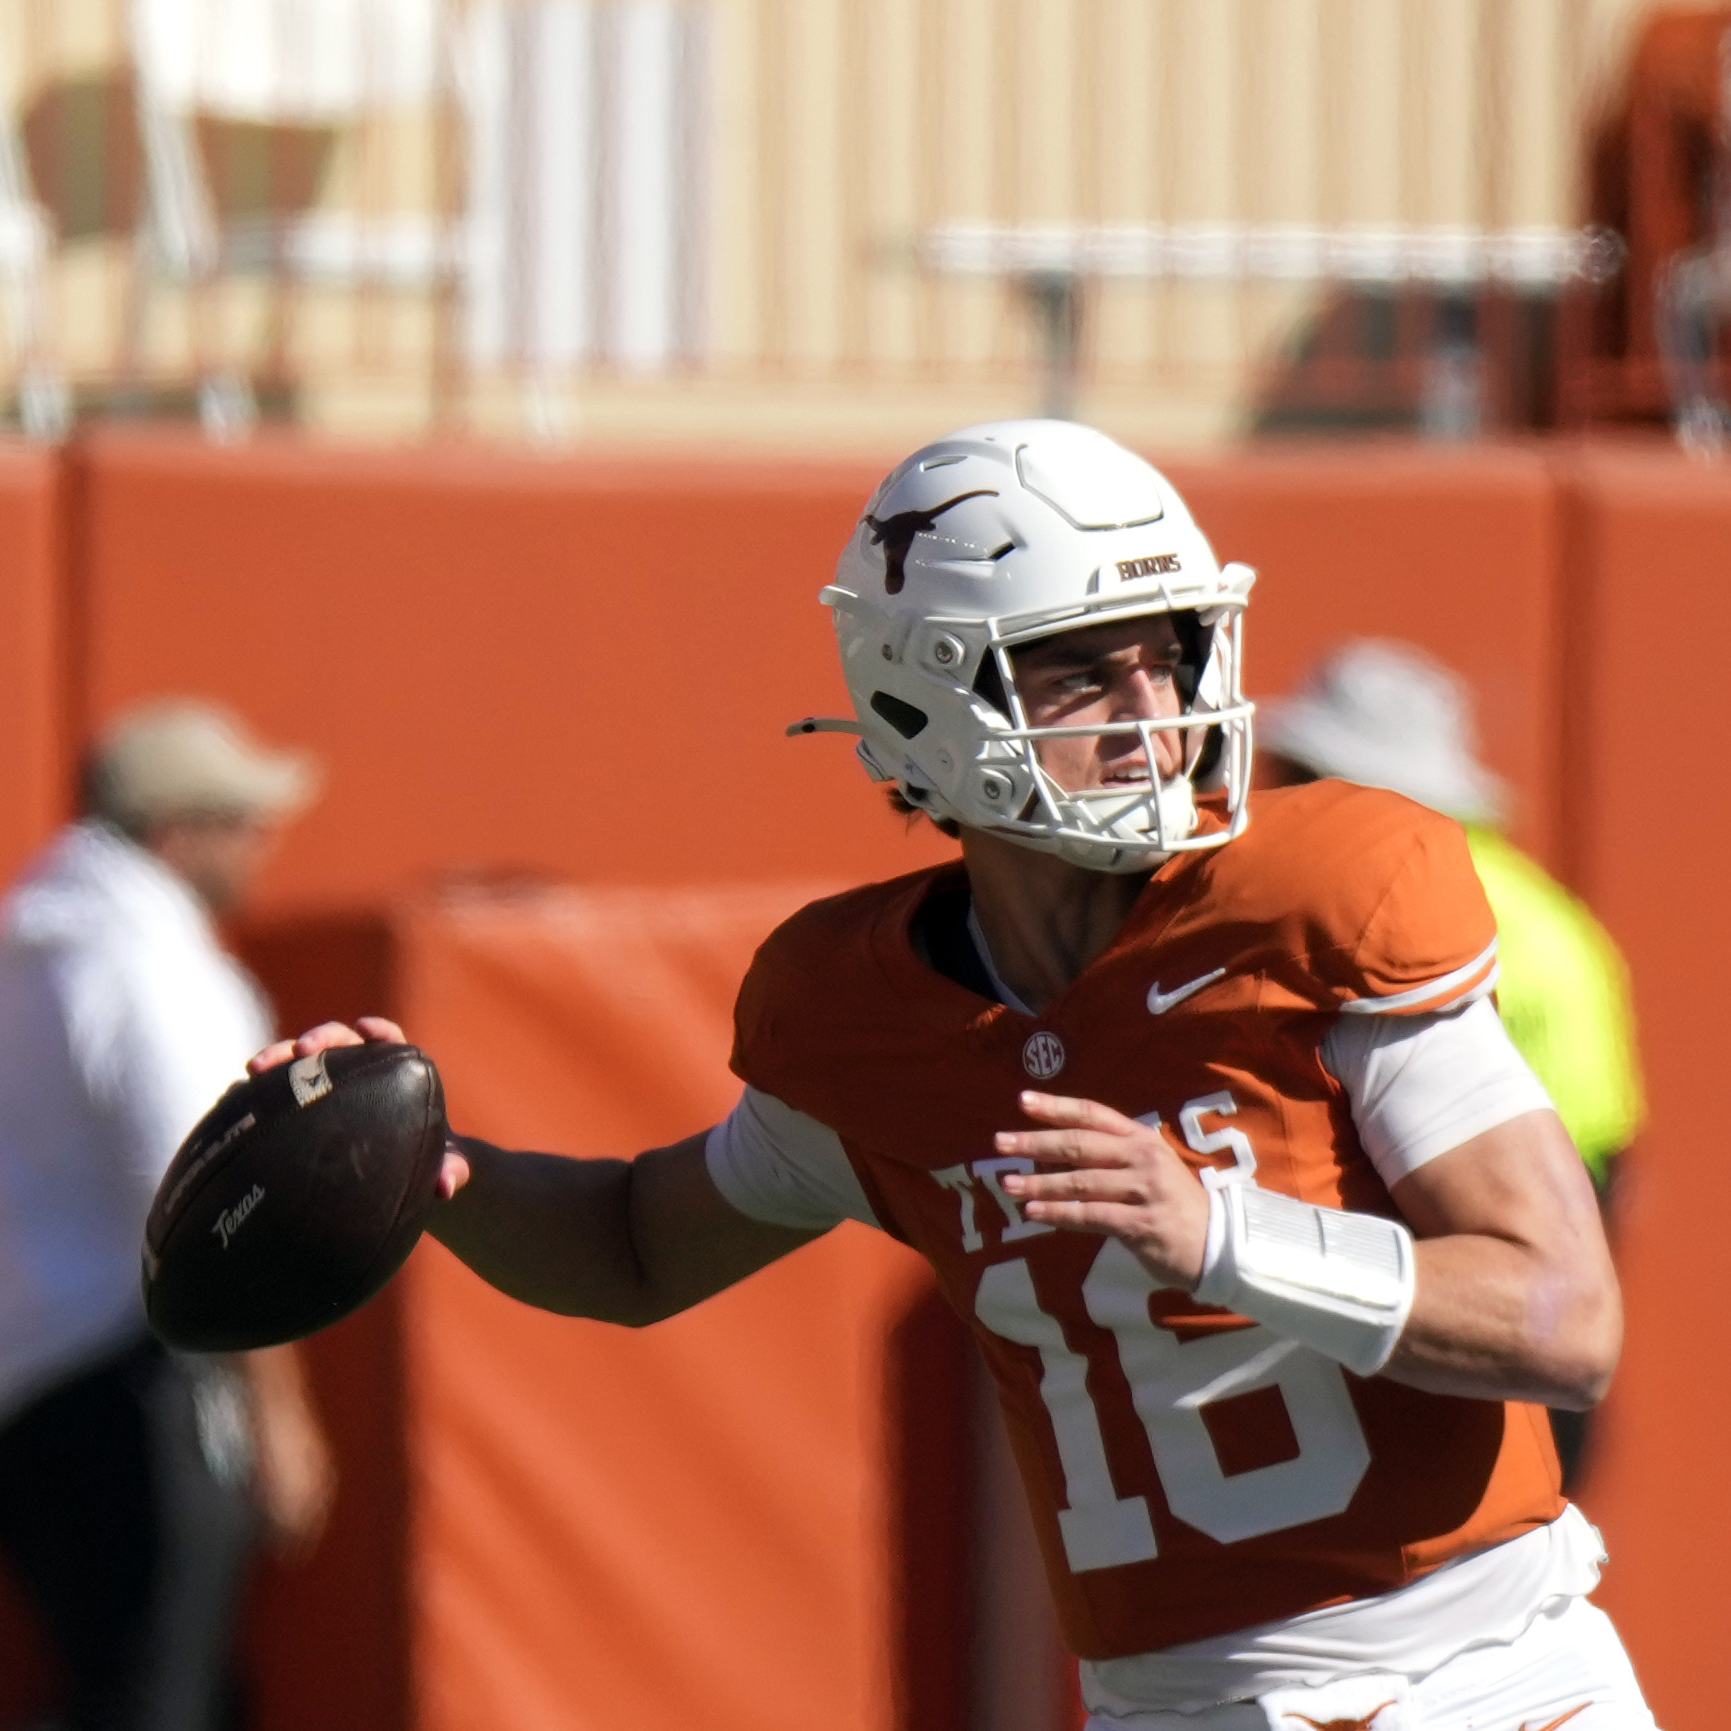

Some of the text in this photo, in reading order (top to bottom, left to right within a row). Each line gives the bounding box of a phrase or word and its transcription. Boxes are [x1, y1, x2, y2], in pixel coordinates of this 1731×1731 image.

[1116, 553, 1181, 582] HORNS
[1025, 1033, 1063, 1077] SEC
[929, 1090, 1258, 1253] TES
[211, 1183, 265, 1250] Texas
[975, 1237, 1371, 1573] 16
